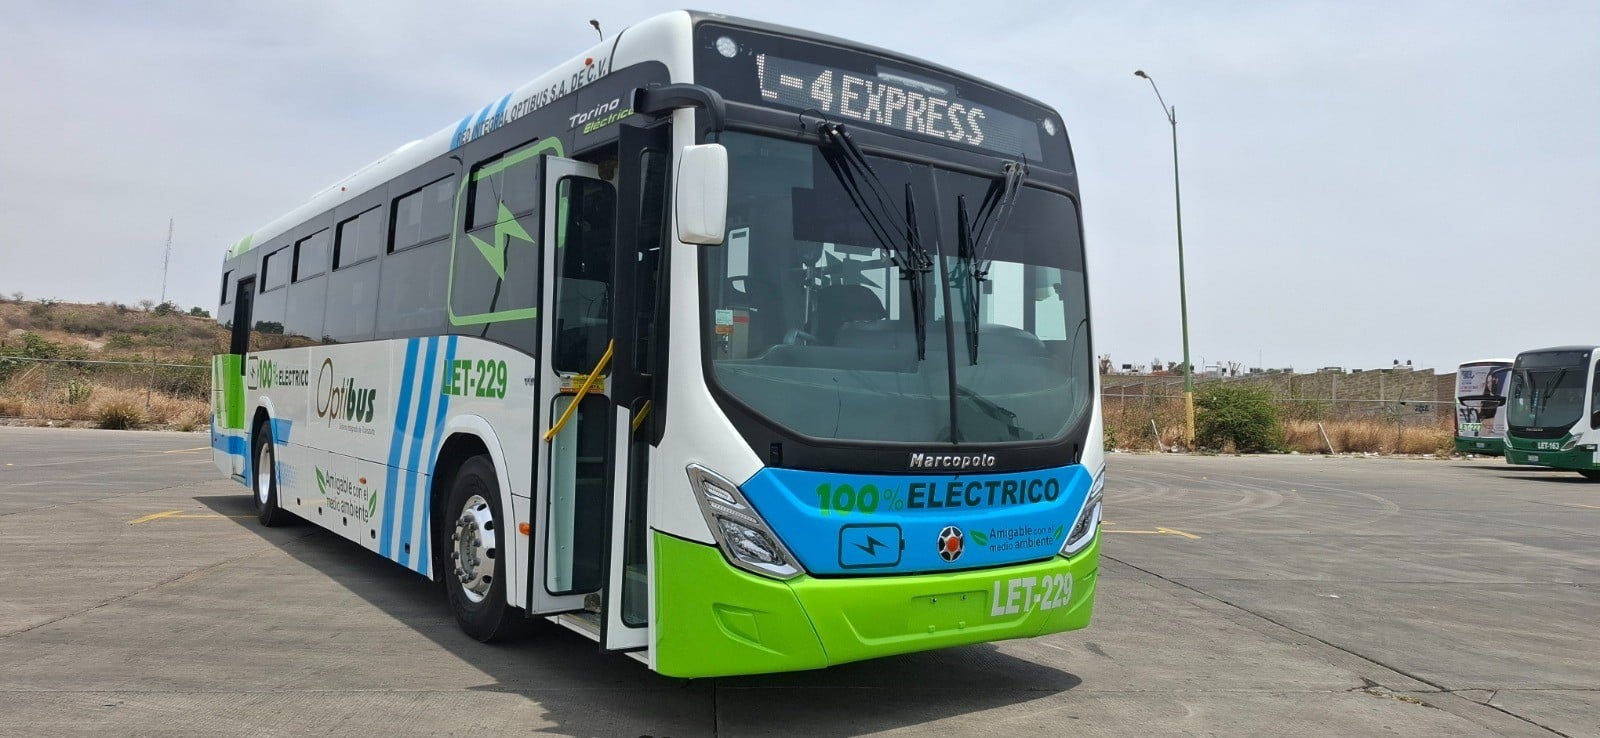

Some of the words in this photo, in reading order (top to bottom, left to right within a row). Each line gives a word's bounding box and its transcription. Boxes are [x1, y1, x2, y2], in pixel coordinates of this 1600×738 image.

[511, 89, 549, 120] OPTIBUS
[550, 80, 568, 102] S.A.
[570, 69, 585, 91] DE
[569, 98, 620, 128] Torino
[840, 74, 986, 146] EXPRESS
[278, 366, 309, 386] ELÉCTRICO
[442, 359, 507, 399] LET-229
[316, 357, 377, 429] Optibus
[909, 452, 996, 468] Marcopolo
[1537, 441, 1560, 450] LET-163
[325, 469, 352, 496] Amigable
[352, 484, 362, 500] con
[906, 474, 1060, 509] ELÉCTRICO
[326, 496, 341, 512] medio
[340, 499, 369, 523] ambiente
[989, 526, 1032, 542] Amigable
[1033, 527, 1046, 536] con
[989, 542, 1014, 553] medio
[1014, 536, 1054, 549] ambiente
[990, 572, 1074, 617] LET-229
